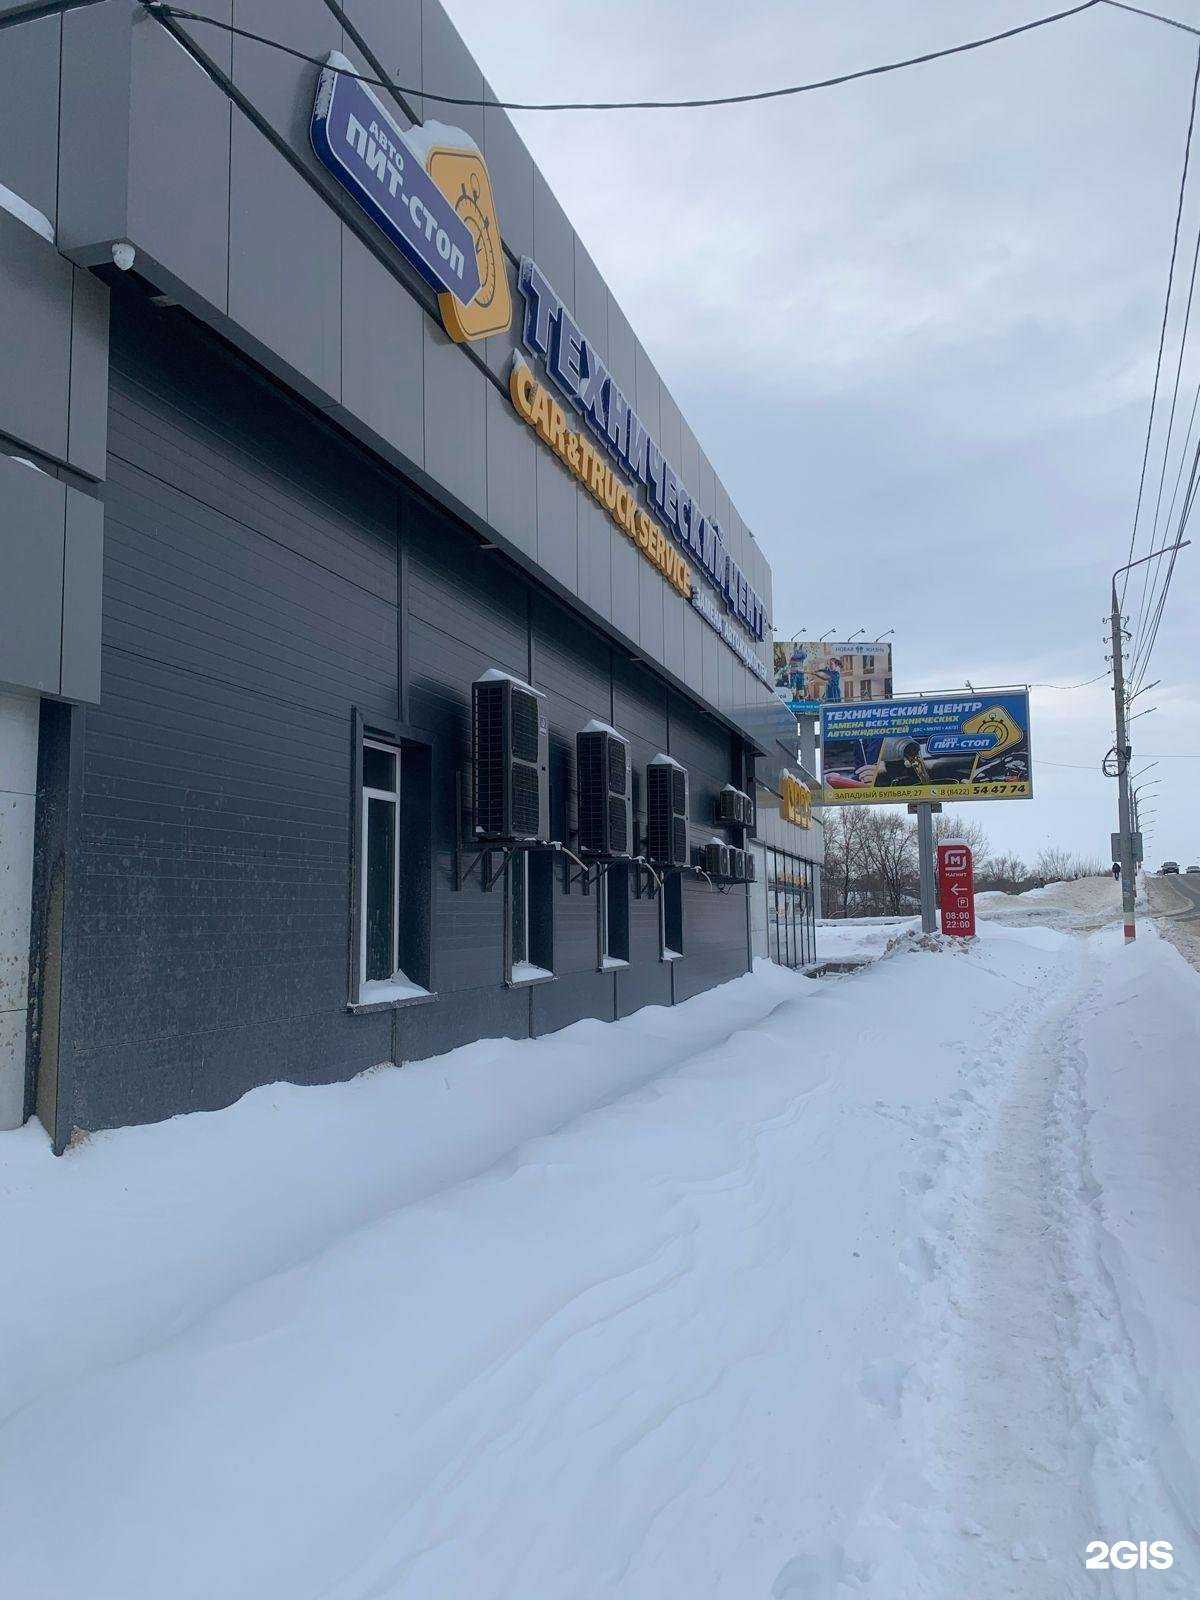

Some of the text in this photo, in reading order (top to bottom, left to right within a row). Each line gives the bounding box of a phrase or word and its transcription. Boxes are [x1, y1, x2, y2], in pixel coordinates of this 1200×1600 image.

[369, 120, 404, 171] АВТО
[345, 112, 465, 280] ПИТ-СТОП
[517, 255, 728, 590] ТЕХНИЧЕСКИЙ
[634, 511, 692, 599] SERVICE
[827, 702, 982, 721] ТЕХНИЧЕСКИЙ ЦЕНТР
[827, 715, 960, 730] ЗАМЕНА ВСЕХ ТЕХНИЧЕСКИХ
[827, 726, 910, 738] АВТОЖИДКОСТЕЙ
[933, 739, 990, 749] ПИТ-СТОП
[835, 790, 877, 800] ЗАПАДНЫЙ
[972, 787, 989, 795] 54
[991, 786, 1006, 794] 47
[1010, 784, 1026, 793] 74
[945, 911, 970, 920] 08:00
[946, 920, 970, 928] 22:00
